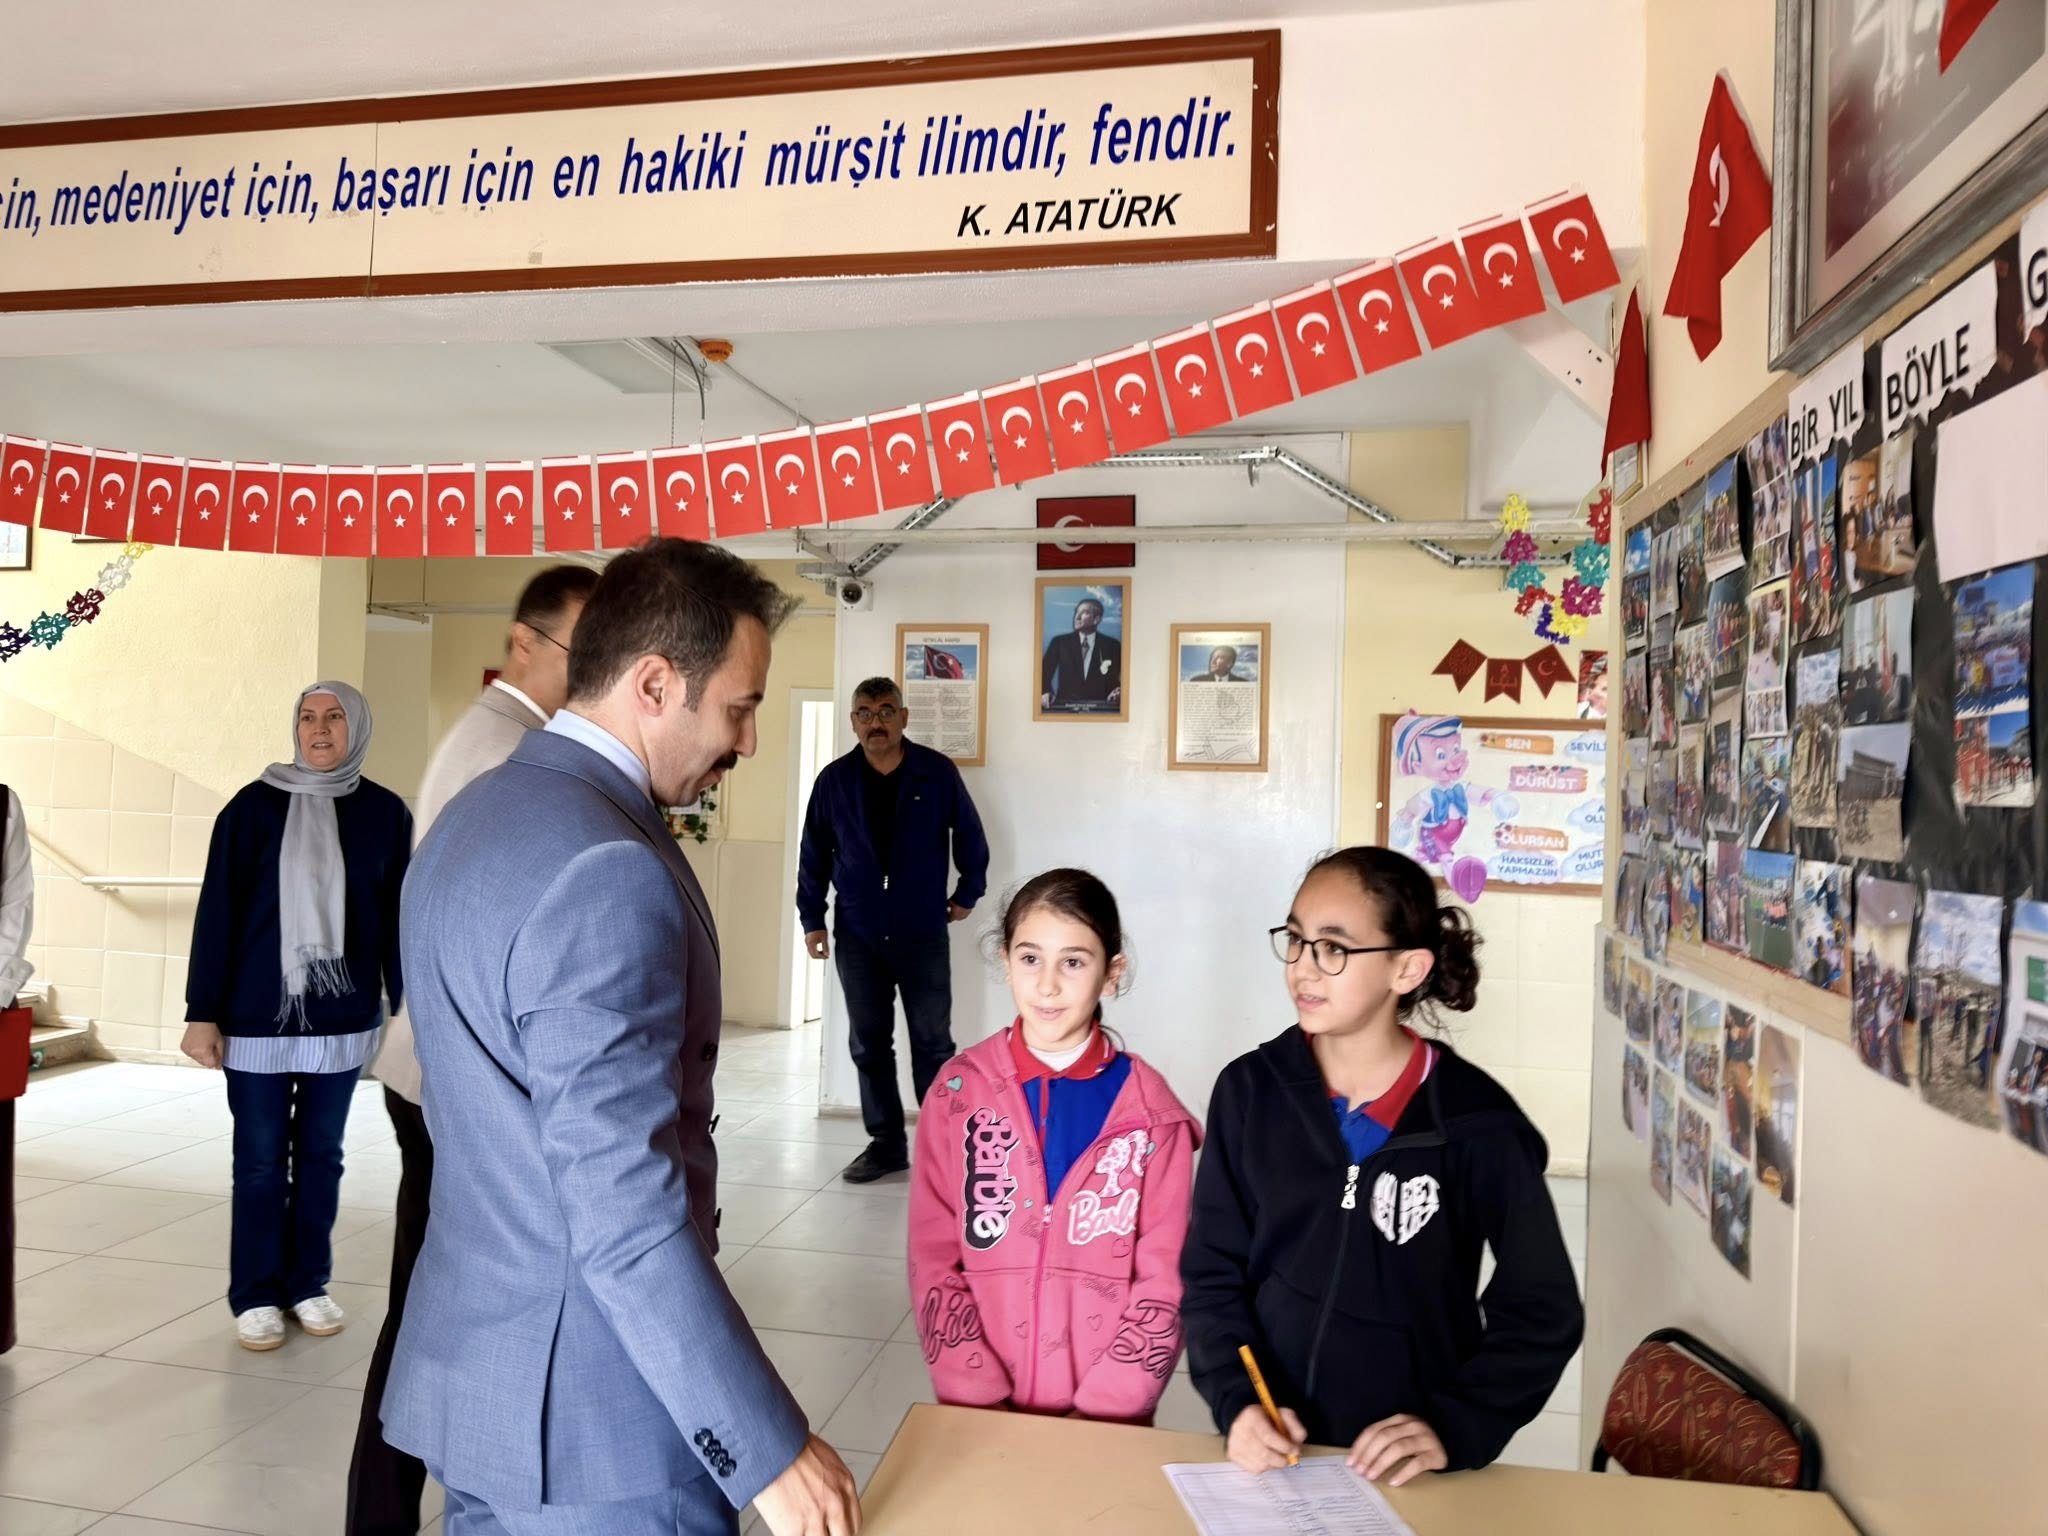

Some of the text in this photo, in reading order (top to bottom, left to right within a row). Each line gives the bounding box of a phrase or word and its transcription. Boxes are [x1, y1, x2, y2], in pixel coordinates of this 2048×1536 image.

[0, 95, 1236, 238] in, medeniyet için, başarı için en hakiki mürşit ilimdir, fendir.
[956, 188, 1181, 238] K. ATATÜRK
[1790, 403, 1819, 462] BİR
[1829, 379, 1859, 434] YIL
[1886, 322, 1971, 422] BÖYLE
[1504, 737, 1532, 750] SEN
[1515, 771, 1578, 790] DÜRÜST
[1502, 833, 1565, 849] OLURSAN
[1501, 855, 1554, 867] HAKSIZLIK
[1497, 865, 1558, 877] YAPMAZSIN
[964, 1107, 1020, 1249] Barbie
